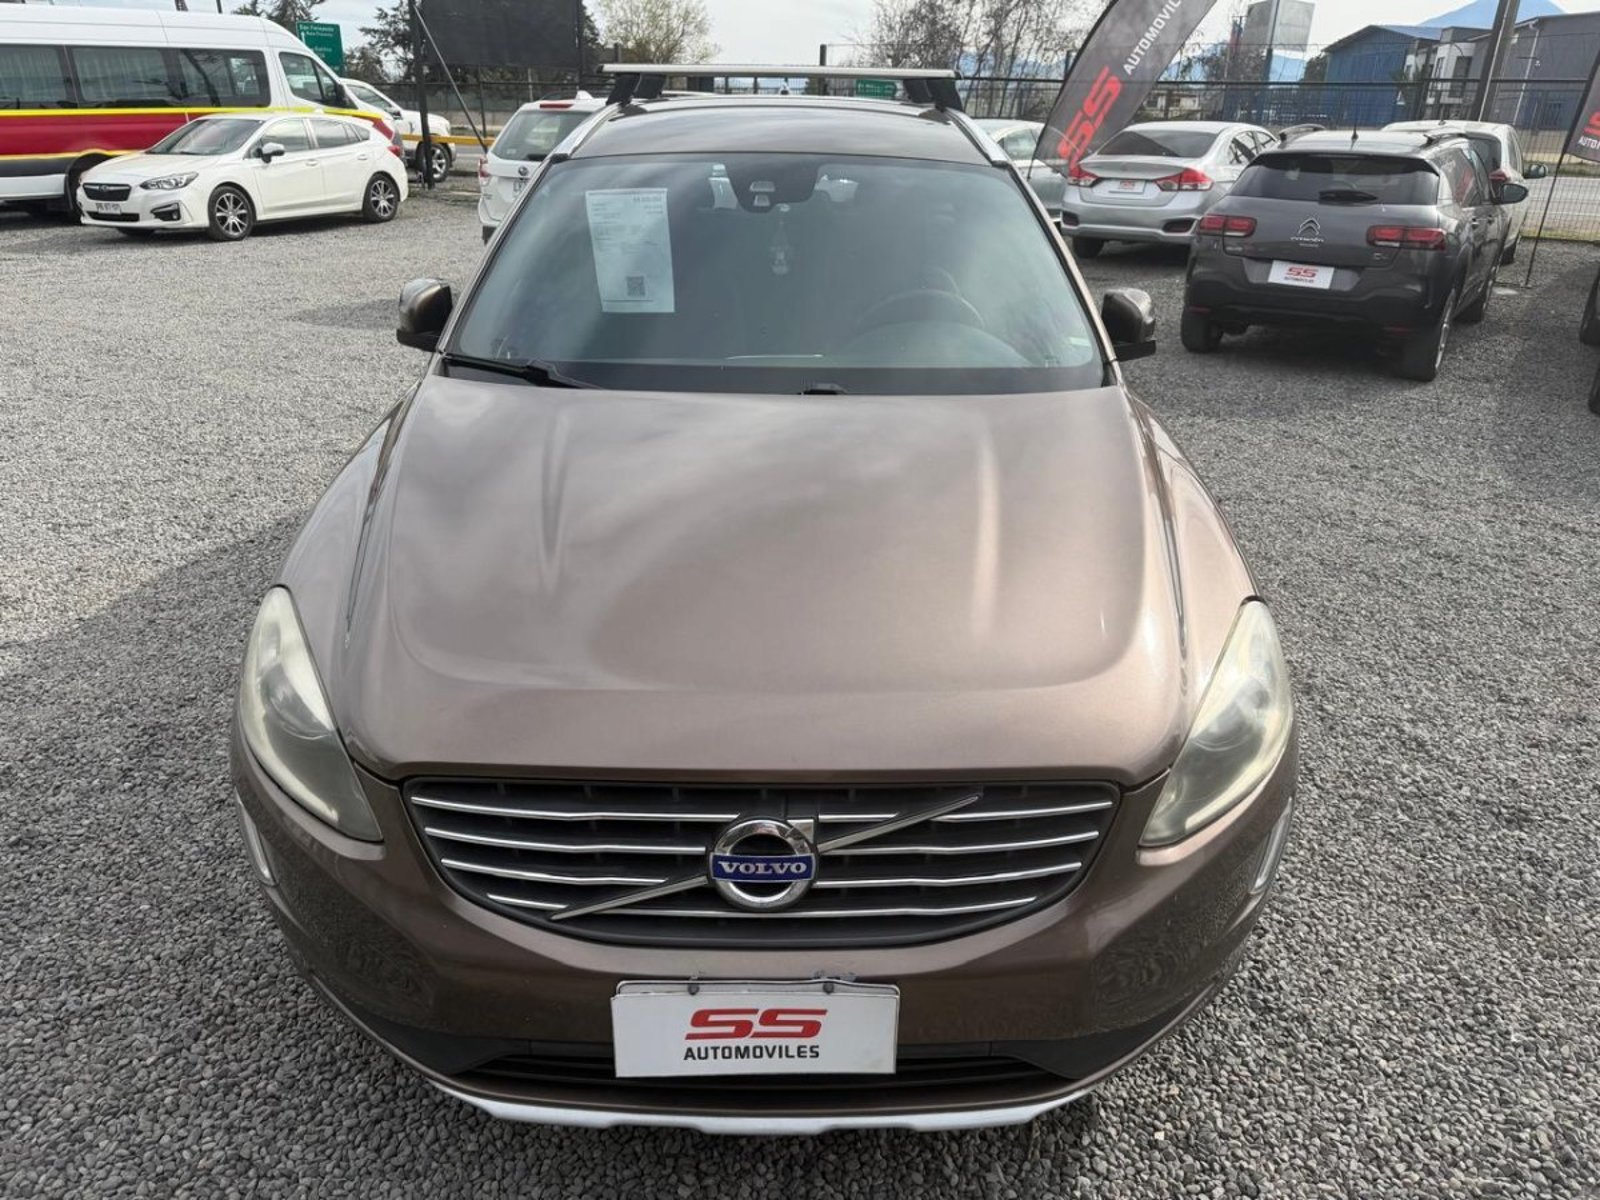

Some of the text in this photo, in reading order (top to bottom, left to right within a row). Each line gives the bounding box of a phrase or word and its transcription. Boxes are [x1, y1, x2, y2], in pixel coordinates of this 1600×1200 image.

[718, 860, 807, 874] VOLVO
[685, 1009, 828, 1040] SS
[684, 1045, 820, 1061] AUTOMOVILES
